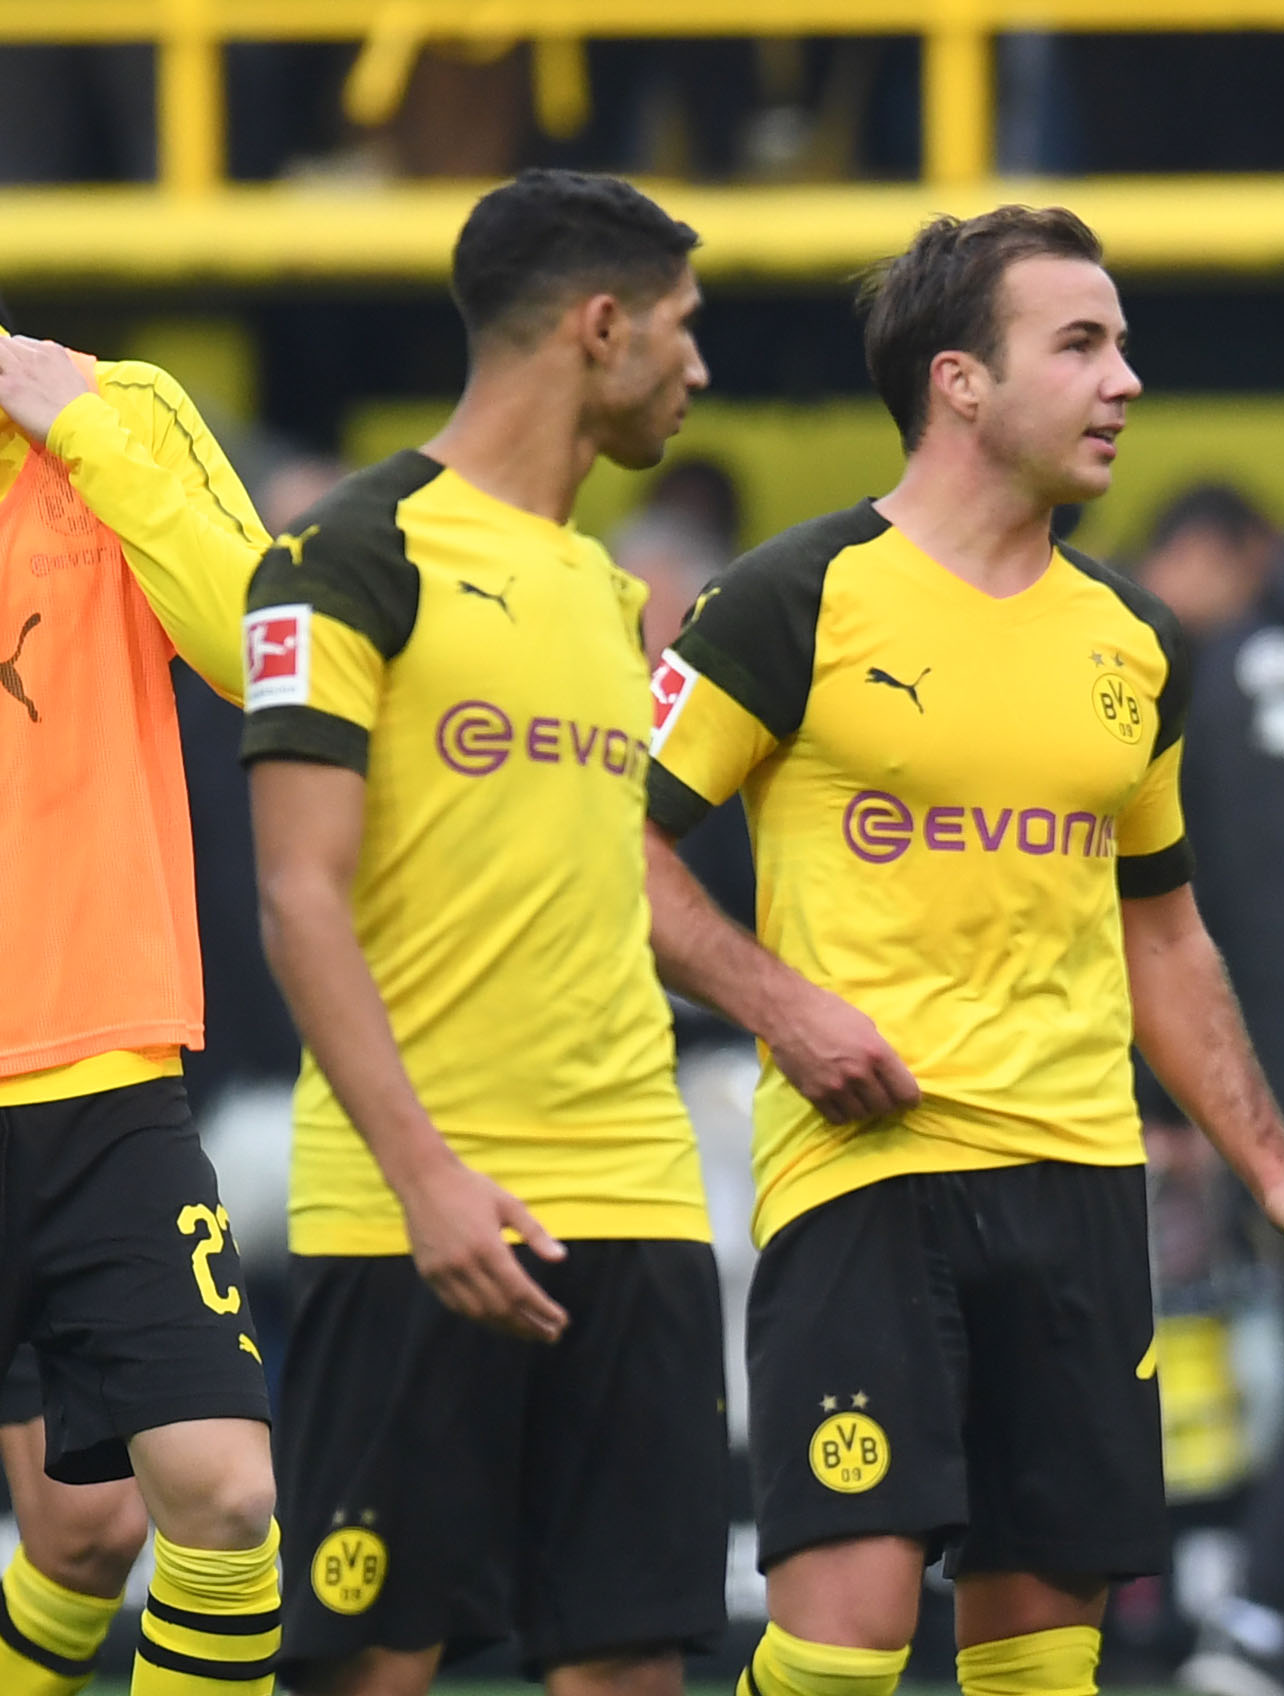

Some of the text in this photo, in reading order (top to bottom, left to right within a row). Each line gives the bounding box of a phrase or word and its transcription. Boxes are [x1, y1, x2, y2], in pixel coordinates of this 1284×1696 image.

[1100, 679, 1140, 724] BVB
[176, 1203, 241, 1315] 2
[823, 1423, 878, 1469] BVB
[326, 1541, 378, 1586] BVB
